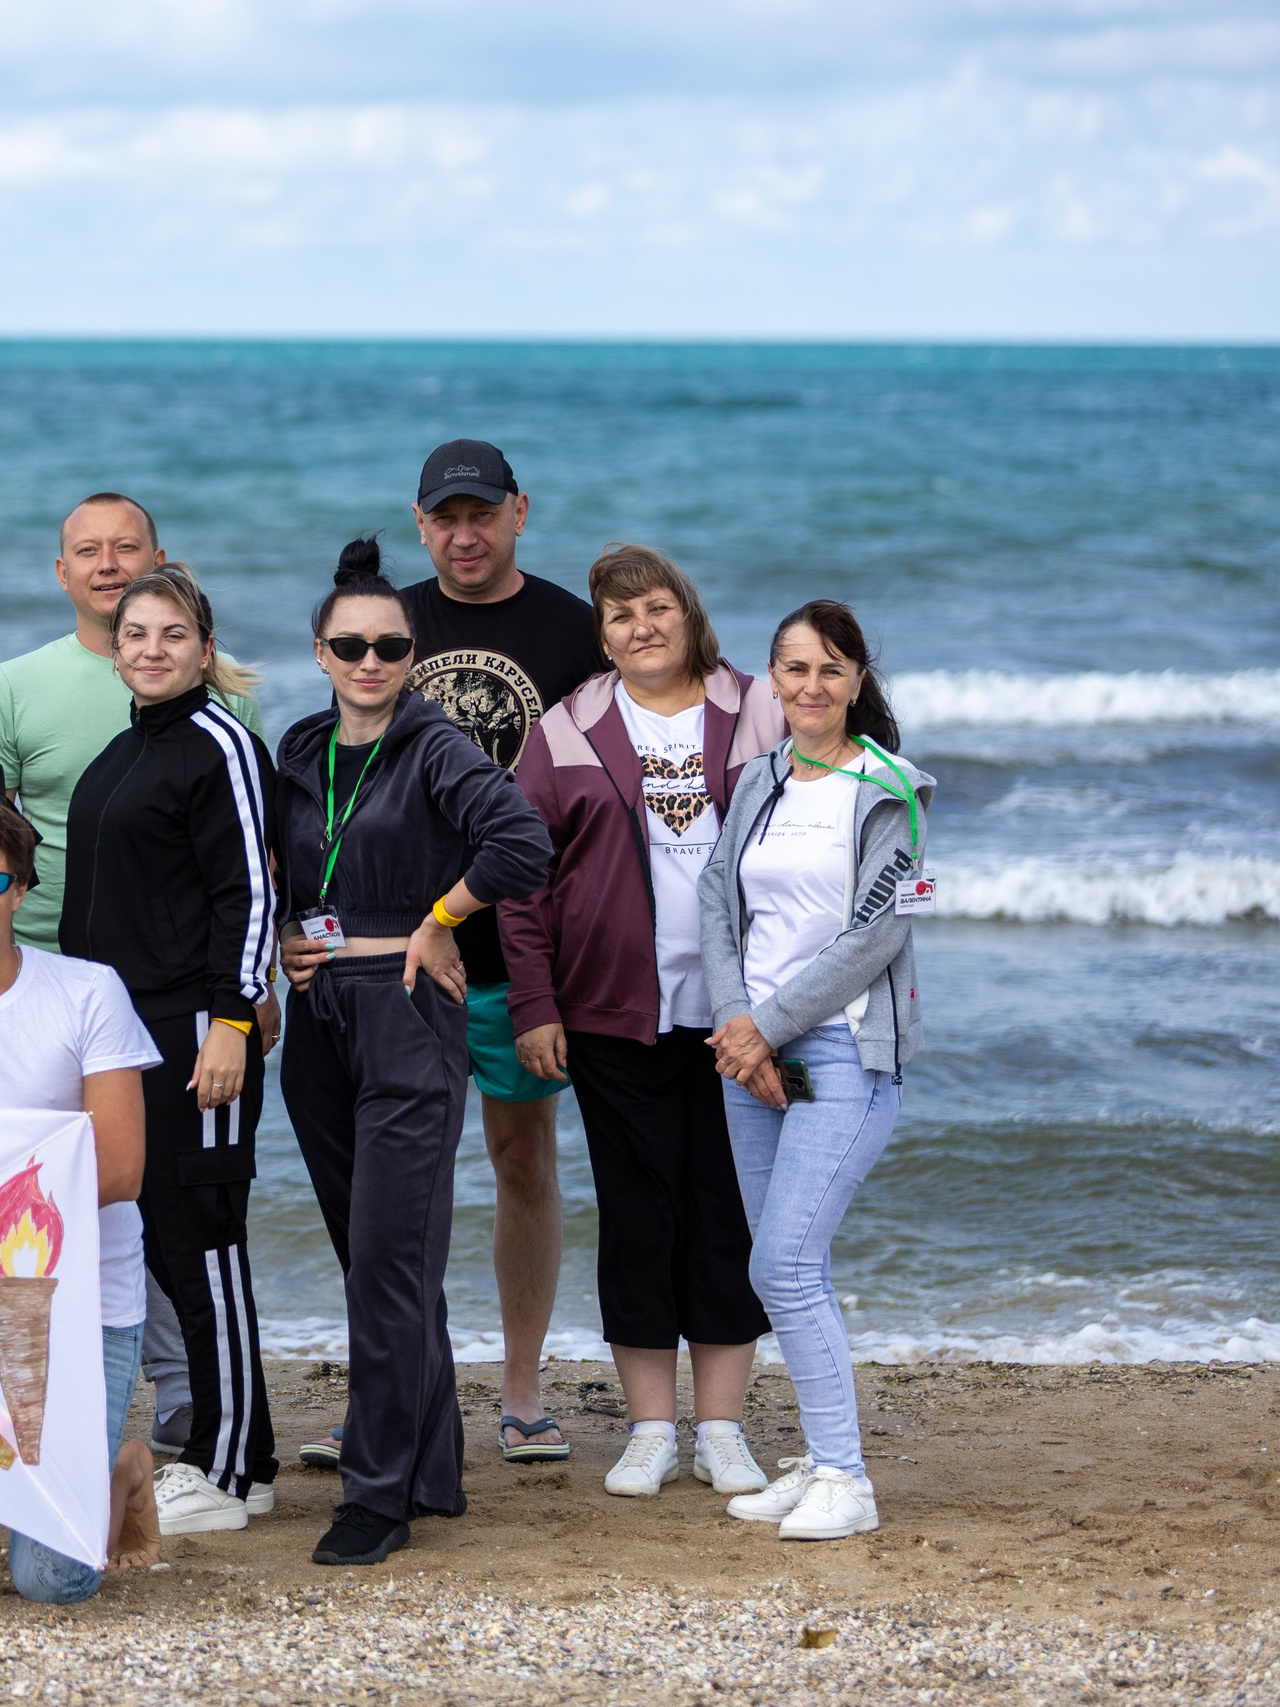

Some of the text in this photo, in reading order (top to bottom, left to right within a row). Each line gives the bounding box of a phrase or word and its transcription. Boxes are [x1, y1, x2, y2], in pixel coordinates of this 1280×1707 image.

[633, 744, 657, 753] REE
[665, 846, 701, 855] BRAVE
[855, 847, 913, 924] PUMA
